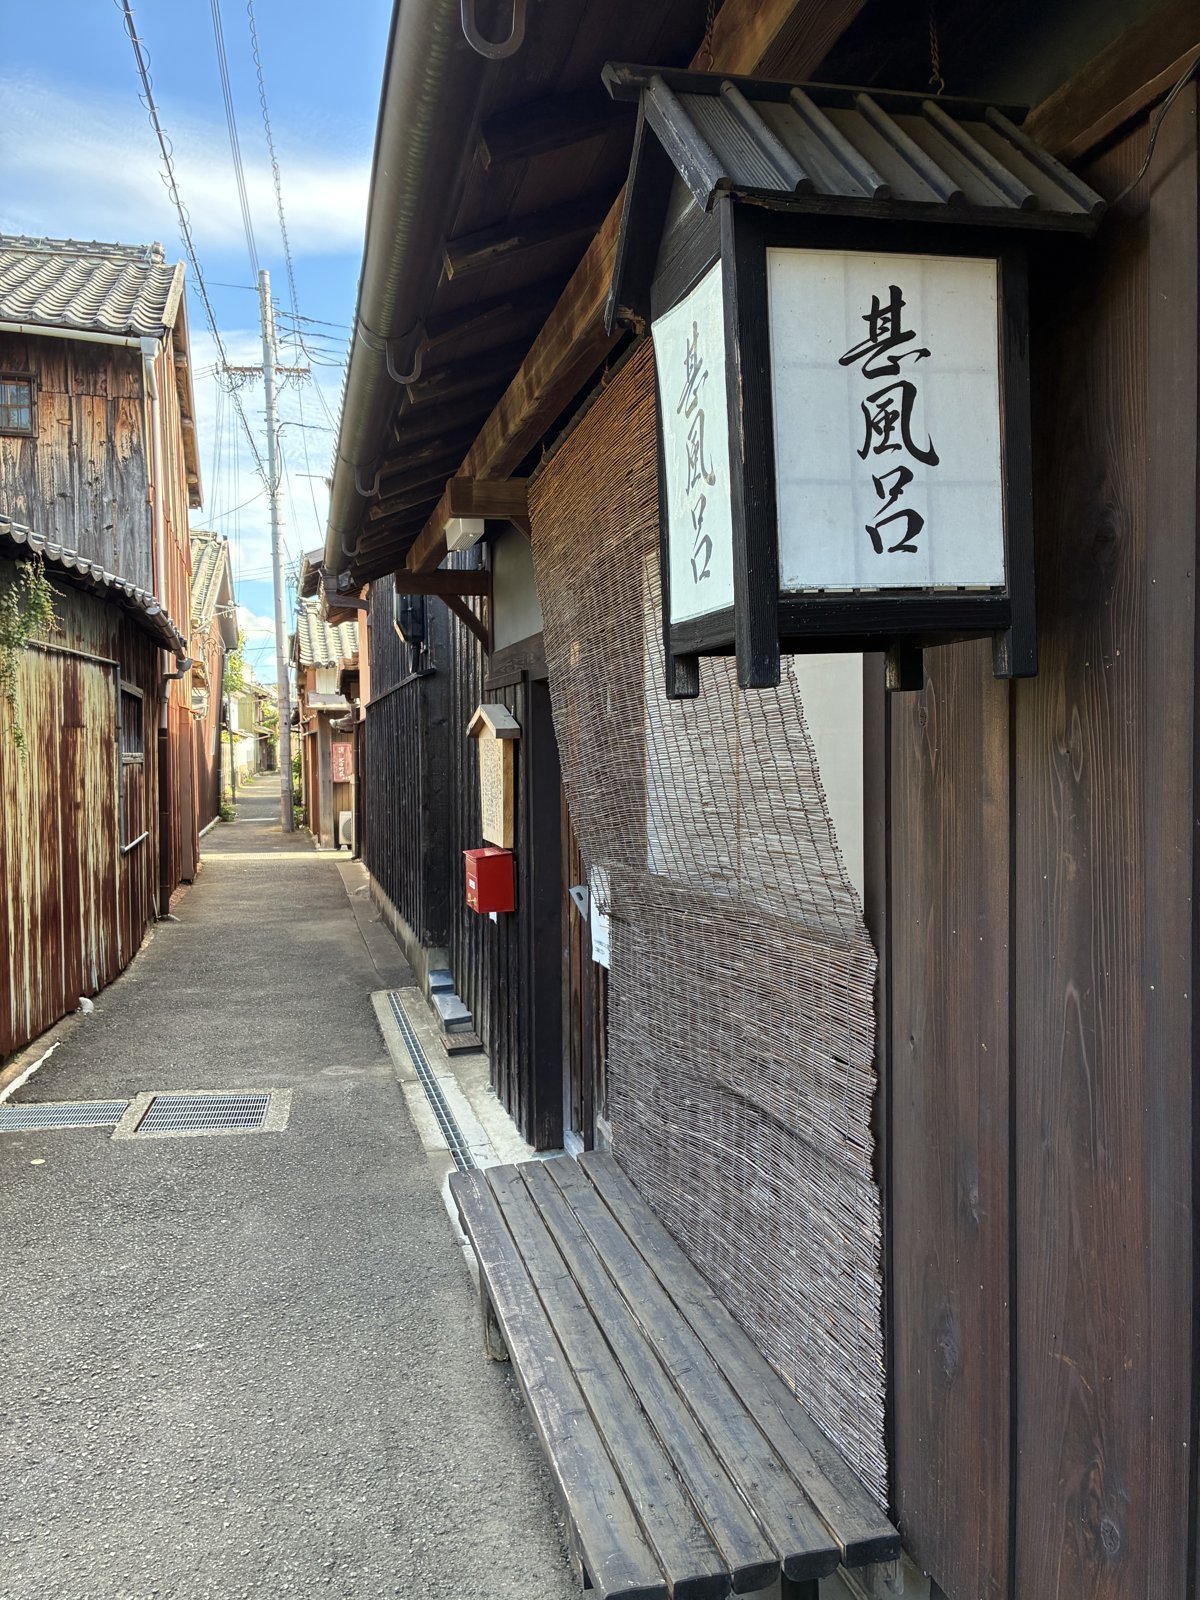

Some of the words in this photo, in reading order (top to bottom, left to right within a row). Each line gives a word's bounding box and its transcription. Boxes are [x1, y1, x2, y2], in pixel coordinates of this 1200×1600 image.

[677, 321, 716, 584] 甚風呂
[838, 285, 940, 554] 甚風呂
